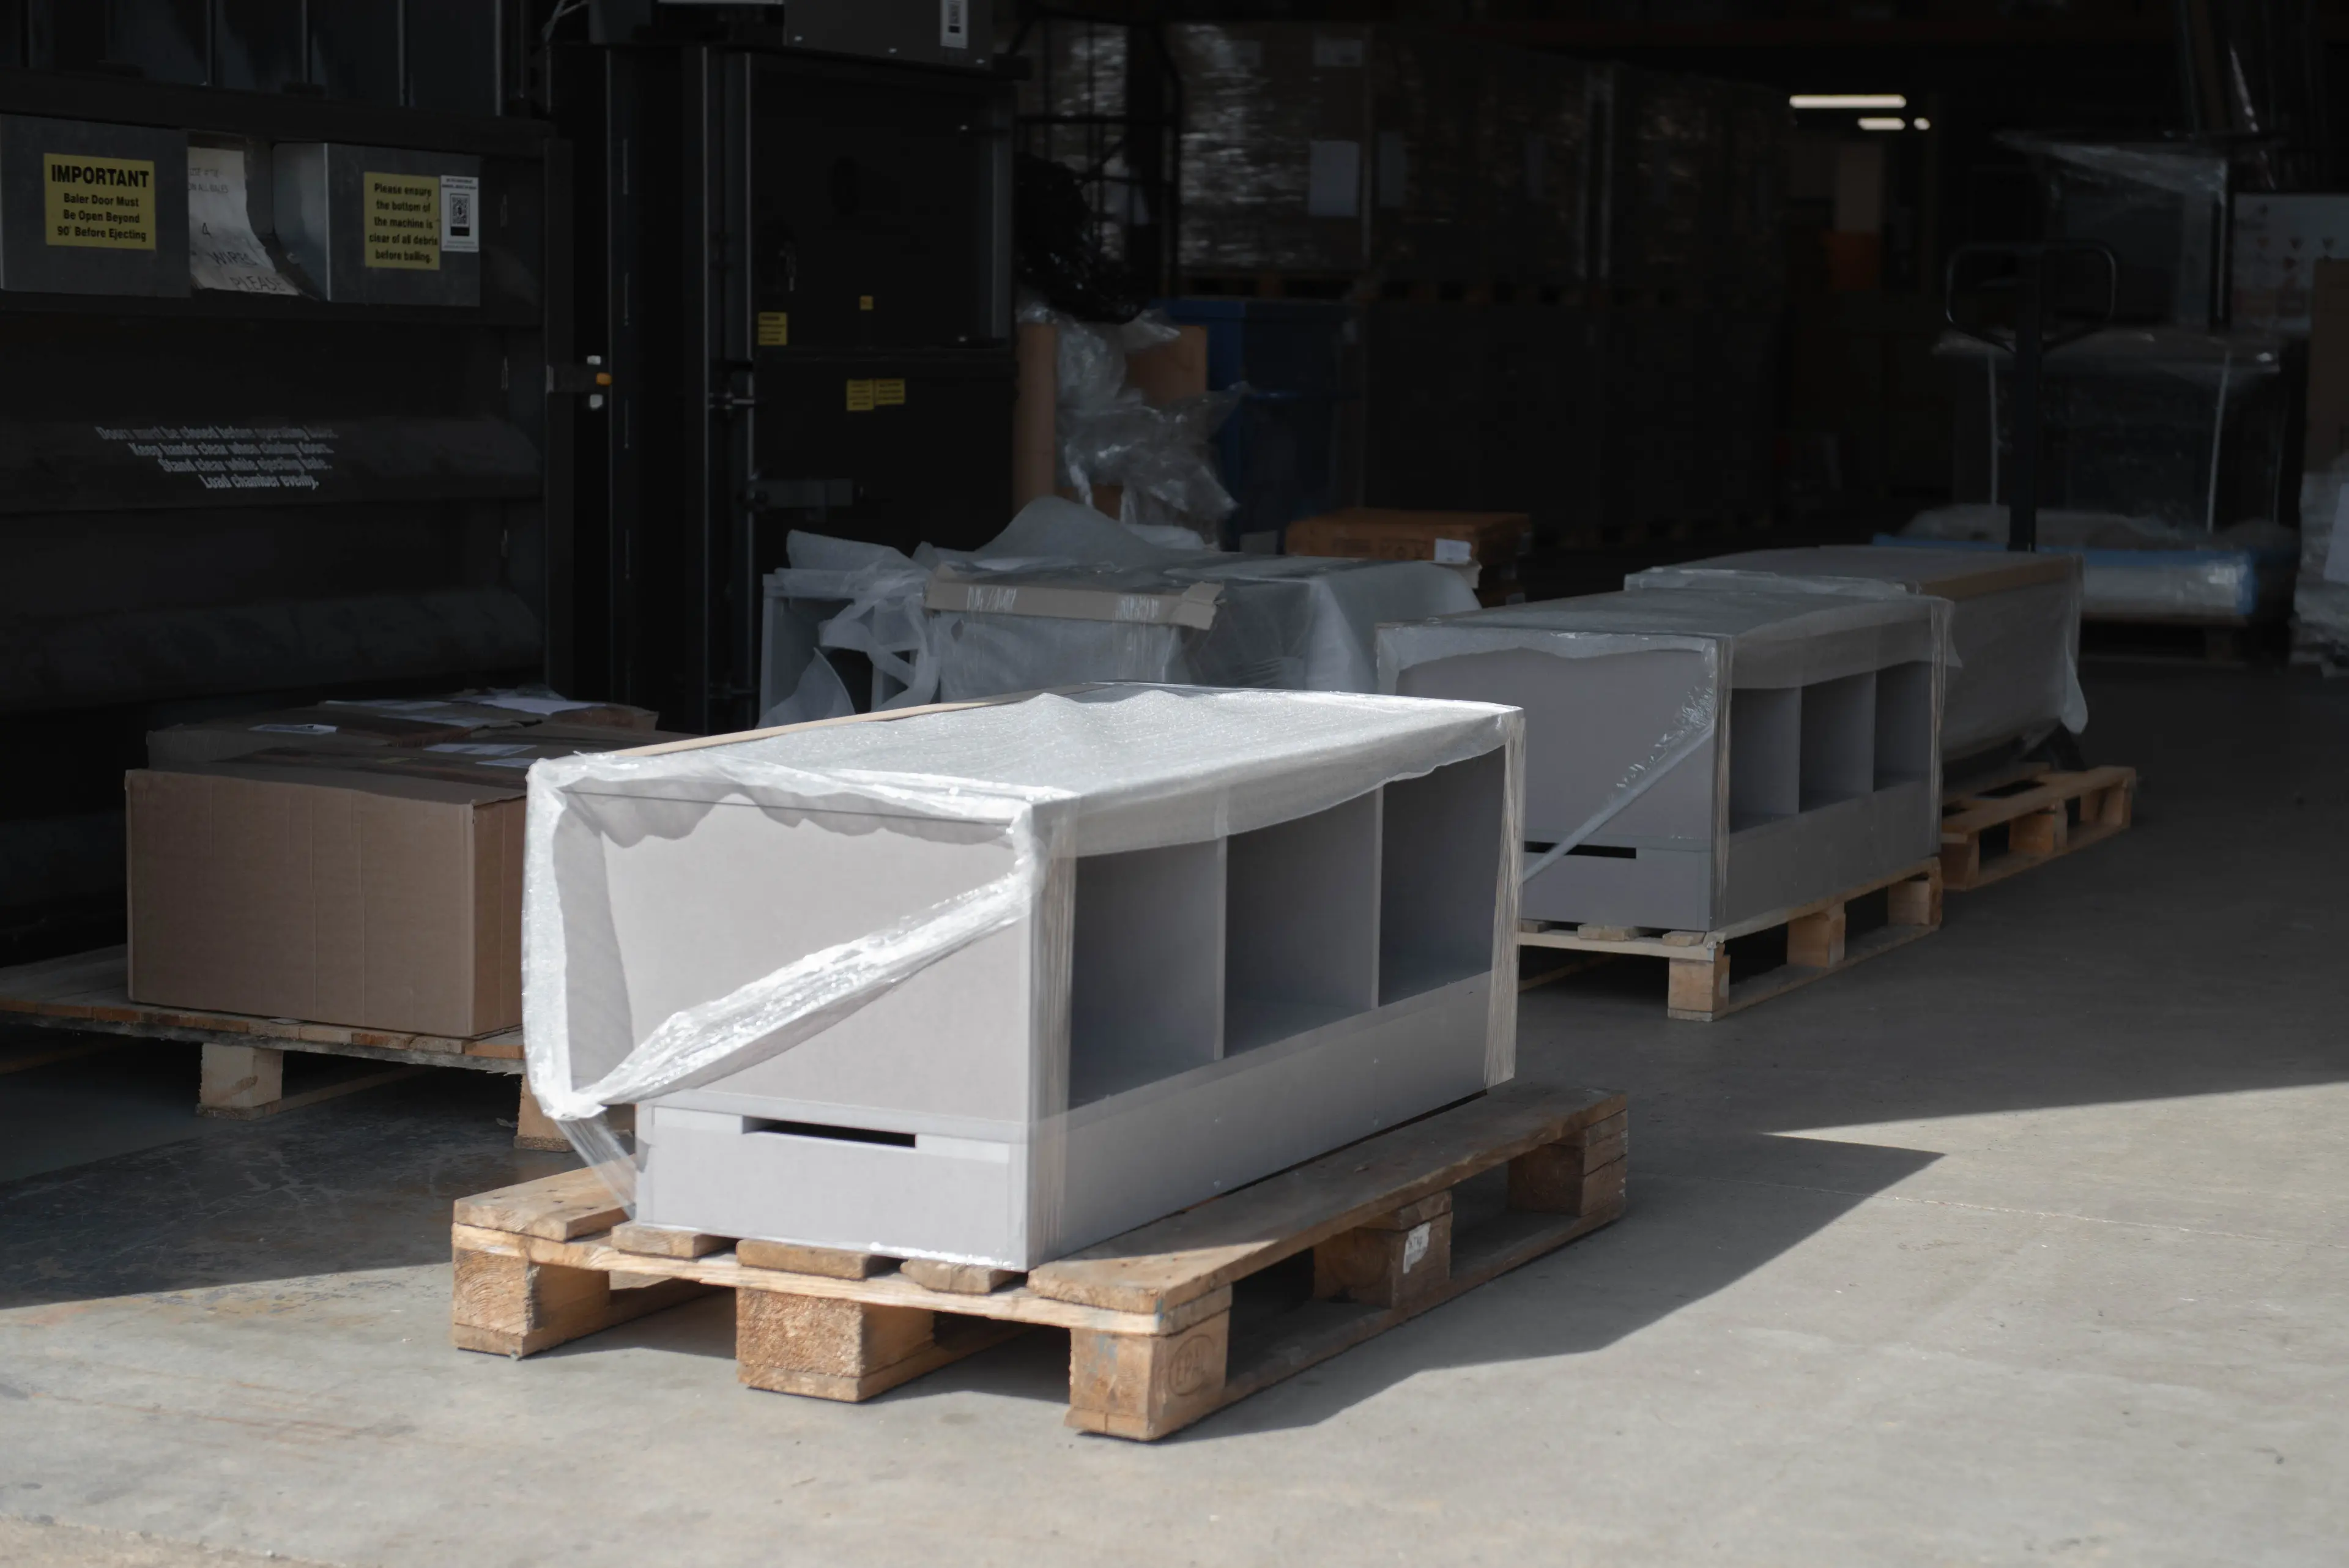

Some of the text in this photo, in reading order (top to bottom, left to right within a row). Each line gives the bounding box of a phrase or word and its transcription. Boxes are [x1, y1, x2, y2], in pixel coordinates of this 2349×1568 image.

[51, 164, 149, 188] IMPORTANT
[374, 183, 402, 195] Please
[404, 187, 432, 197] ensure
[64, 193, 139, 207] Baler Door Must
[376, 199, 431, 212] the bottom of
[64, 209, 140, 225] Be Open Beyond
[374, 216, 433, 229] the machine is
[75, 226, 106, 237] Before
[109, 228, 146, 242] Ejecting
[369, 233, 390, 243] clear
[392, 234, 400, 243] of
[402, 234, 411, 244] all
[414, 235, 438, 245] debris
[376, 249, 402, 260] before
[229, 275, 286, 292] PLEASE
[158, 458, 198, 472] Stand
[195, 458, 226, 471] clear
[225, 457, 259, 471] while
[198, 474, 320, 490] Load chamber evenly.
